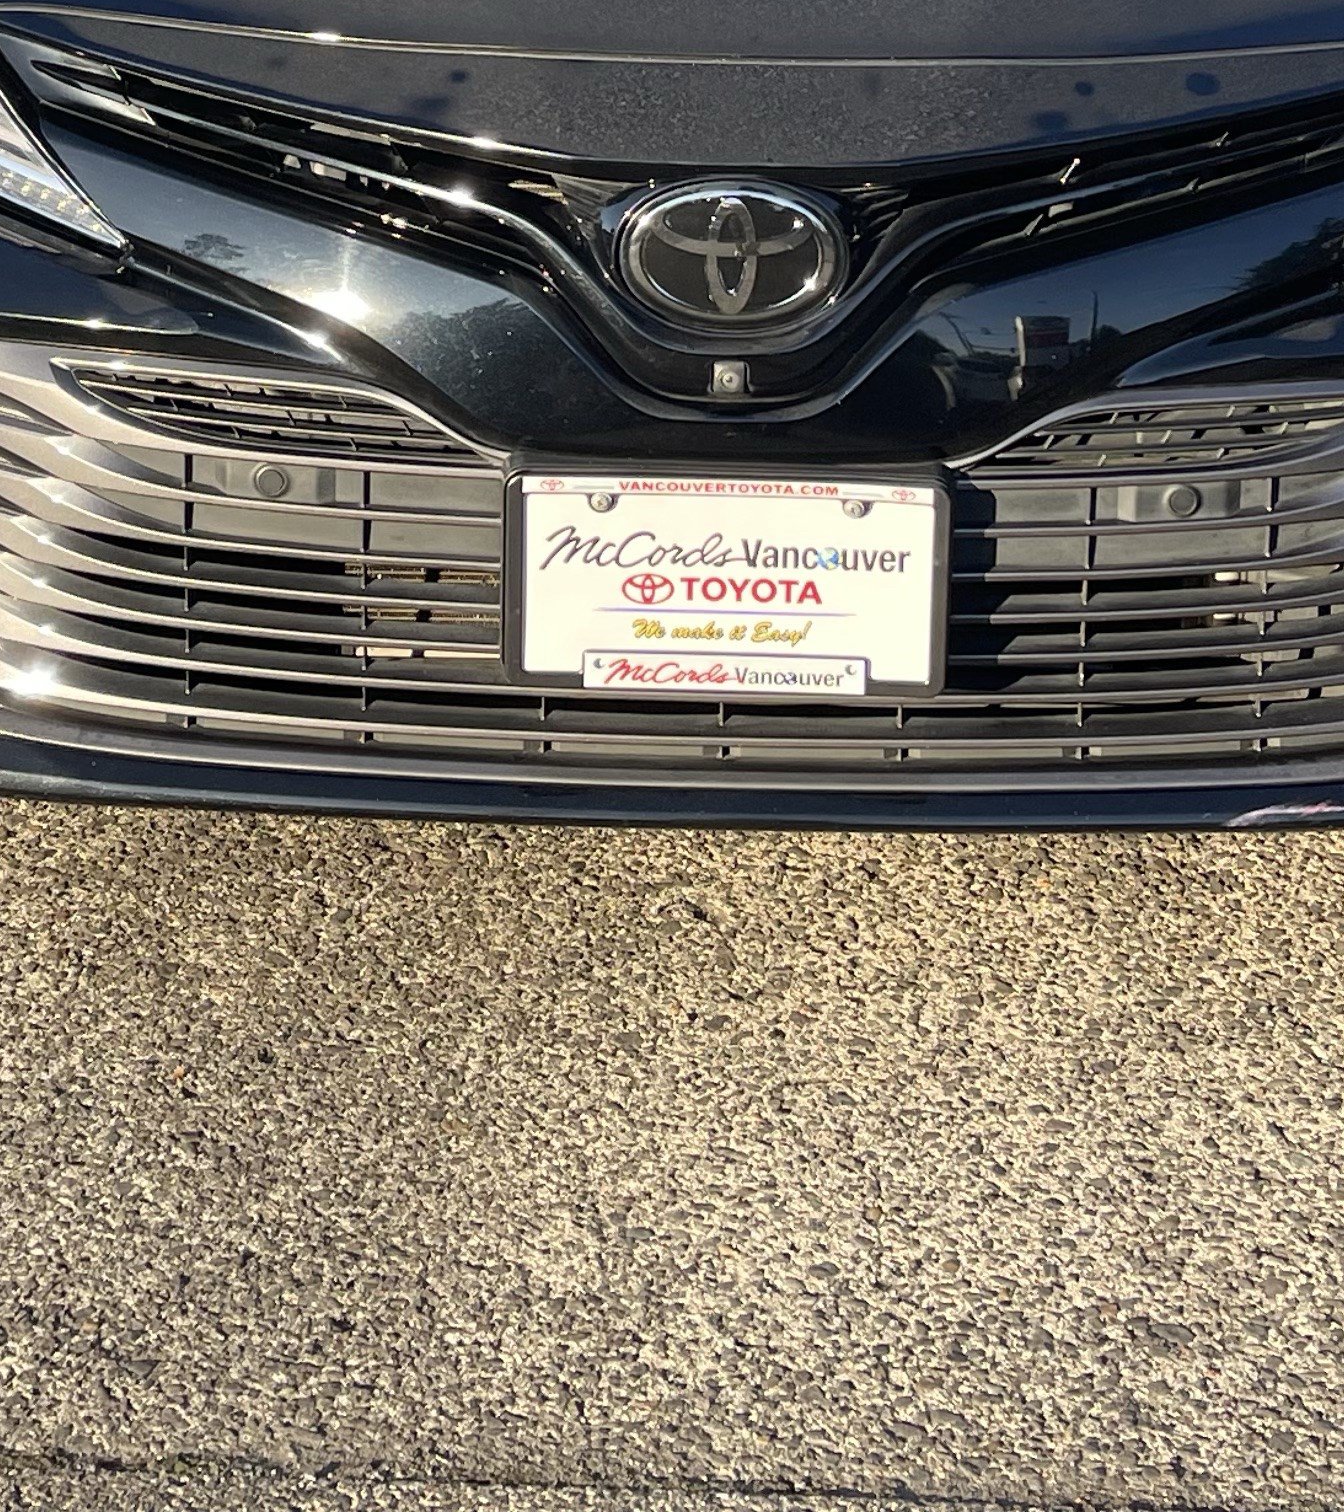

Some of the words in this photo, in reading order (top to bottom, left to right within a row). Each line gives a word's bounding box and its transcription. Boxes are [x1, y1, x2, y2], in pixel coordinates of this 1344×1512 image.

[619, 480, 840, 497] VANCOUVERTOYOTA.COM
[681, 576, 823, 605] TOYOTA
[632, 618, 666, 639] We
[670, 620, 725, 640] make
[728, 624, 748, 641] it
[750, 620, 813, 648] Easy!
